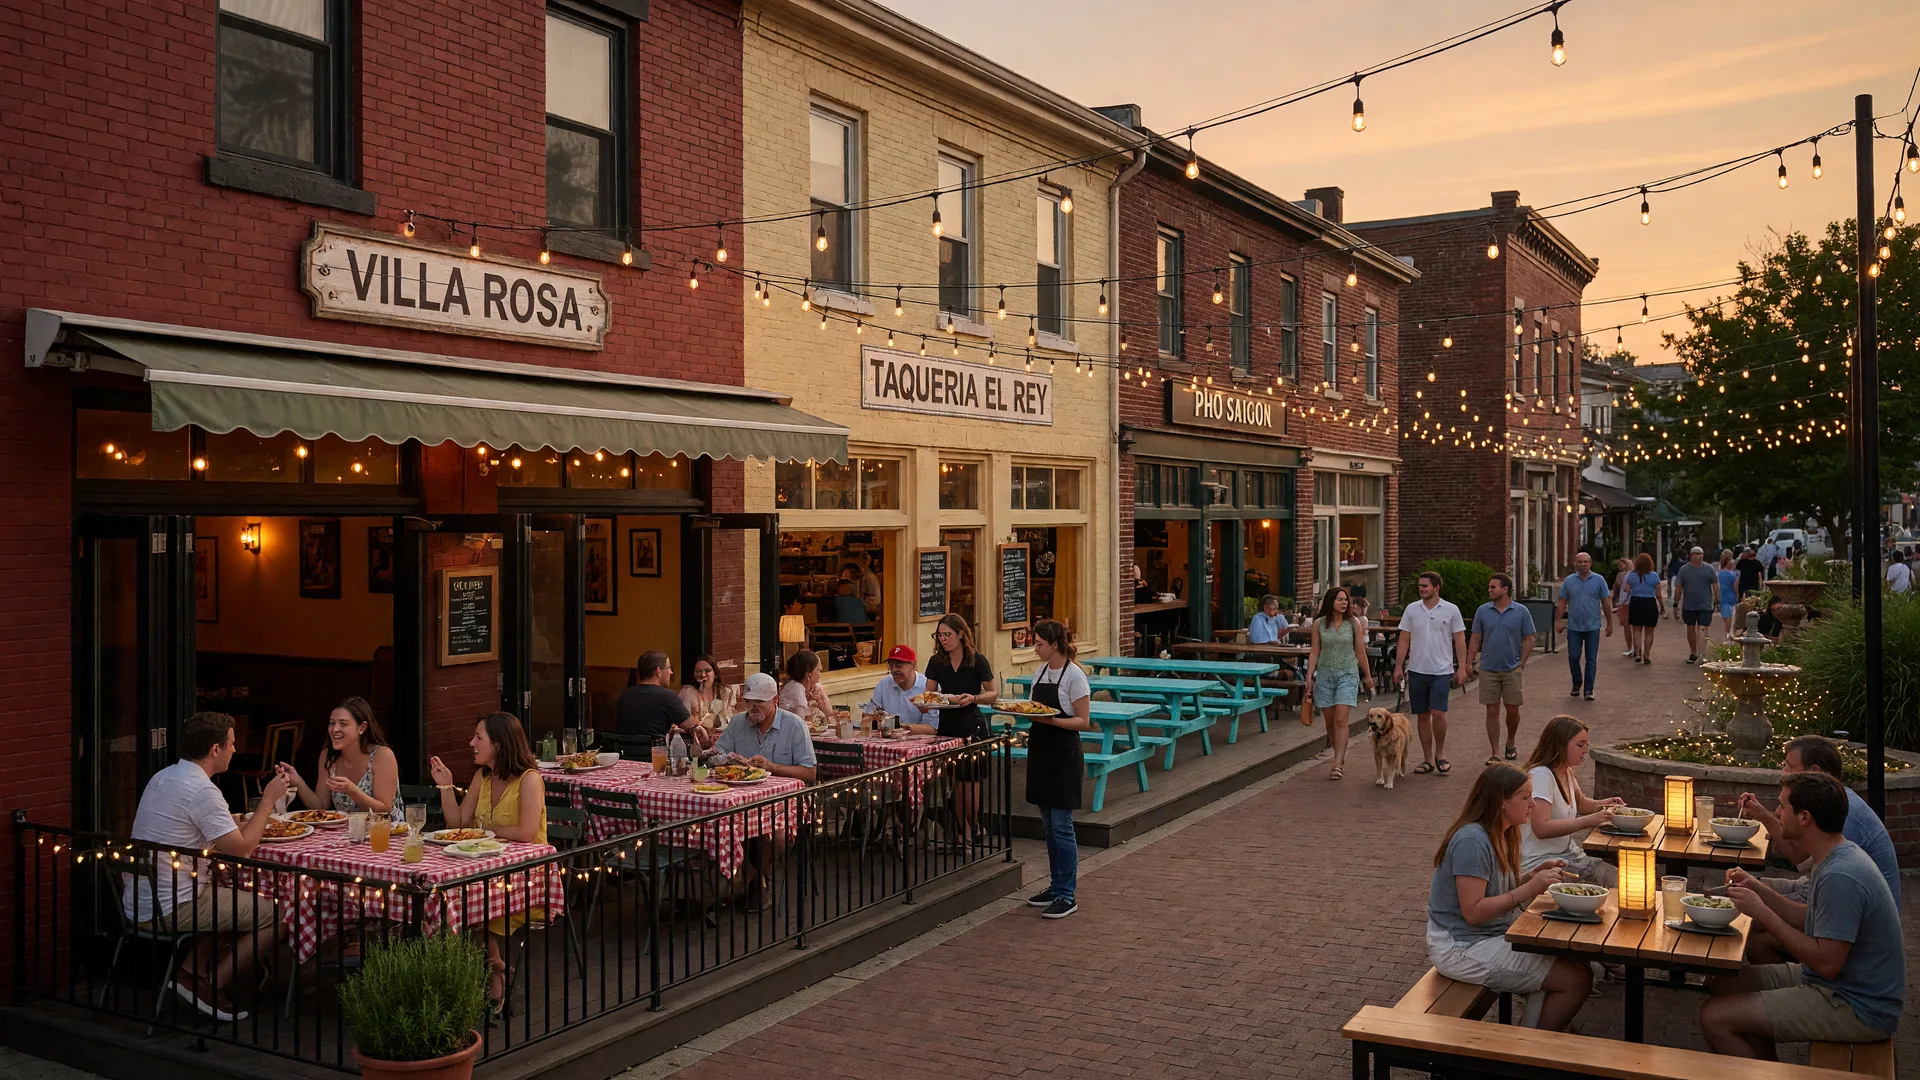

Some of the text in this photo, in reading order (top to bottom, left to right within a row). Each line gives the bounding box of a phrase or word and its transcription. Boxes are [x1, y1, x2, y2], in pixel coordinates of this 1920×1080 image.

[346, 249, 583, 331] VILLA ROSA
[870, 358, 1048, 415] TAQUERIA EL REY
[1195, 390, 1272, 428] PHO SAIGON
